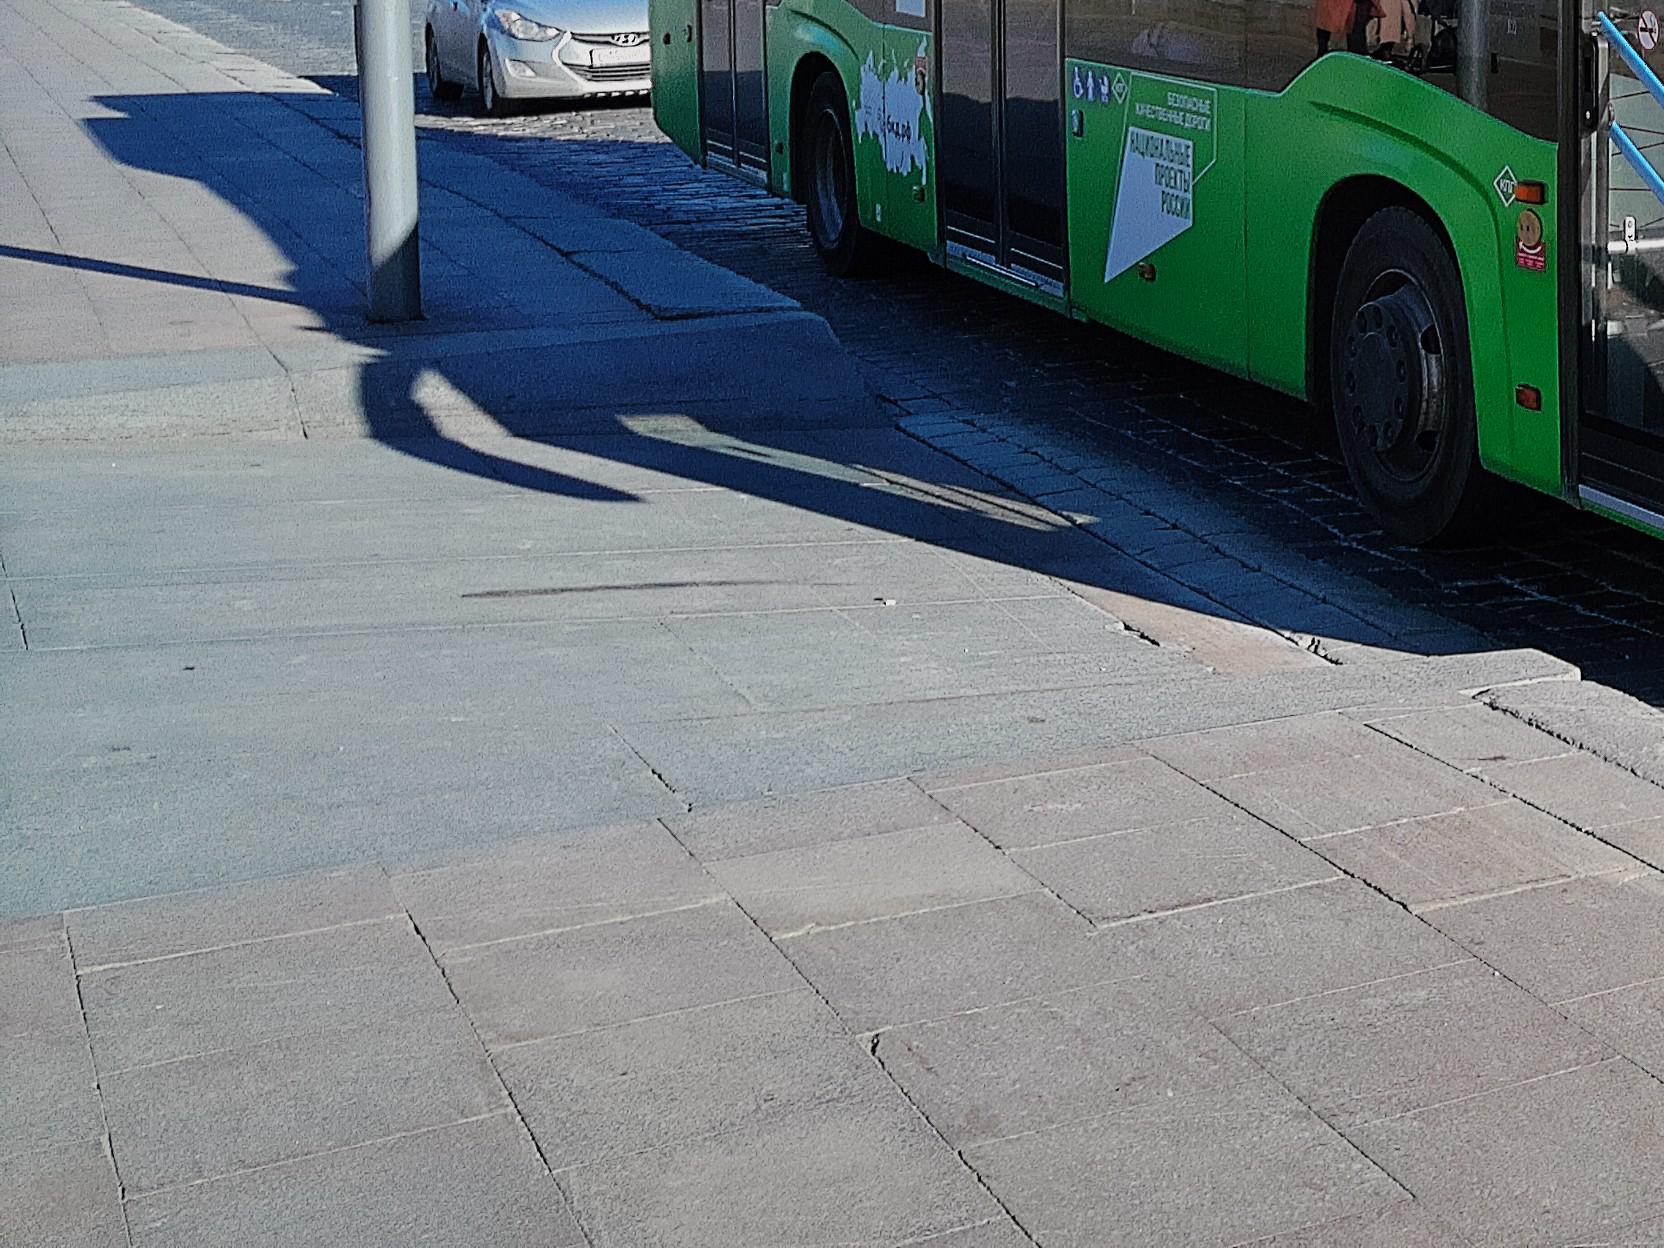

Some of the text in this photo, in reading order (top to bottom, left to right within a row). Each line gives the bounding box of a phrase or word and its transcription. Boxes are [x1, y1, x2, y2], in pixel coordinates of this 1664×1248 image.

[1131, 130, 1190, 168] НАЦИОНАЛЬНЫЕ
[1155, 162, 1190, 193] ПРОЕКТЫ
[1161, 190, 1190, 219] РОССИИ
